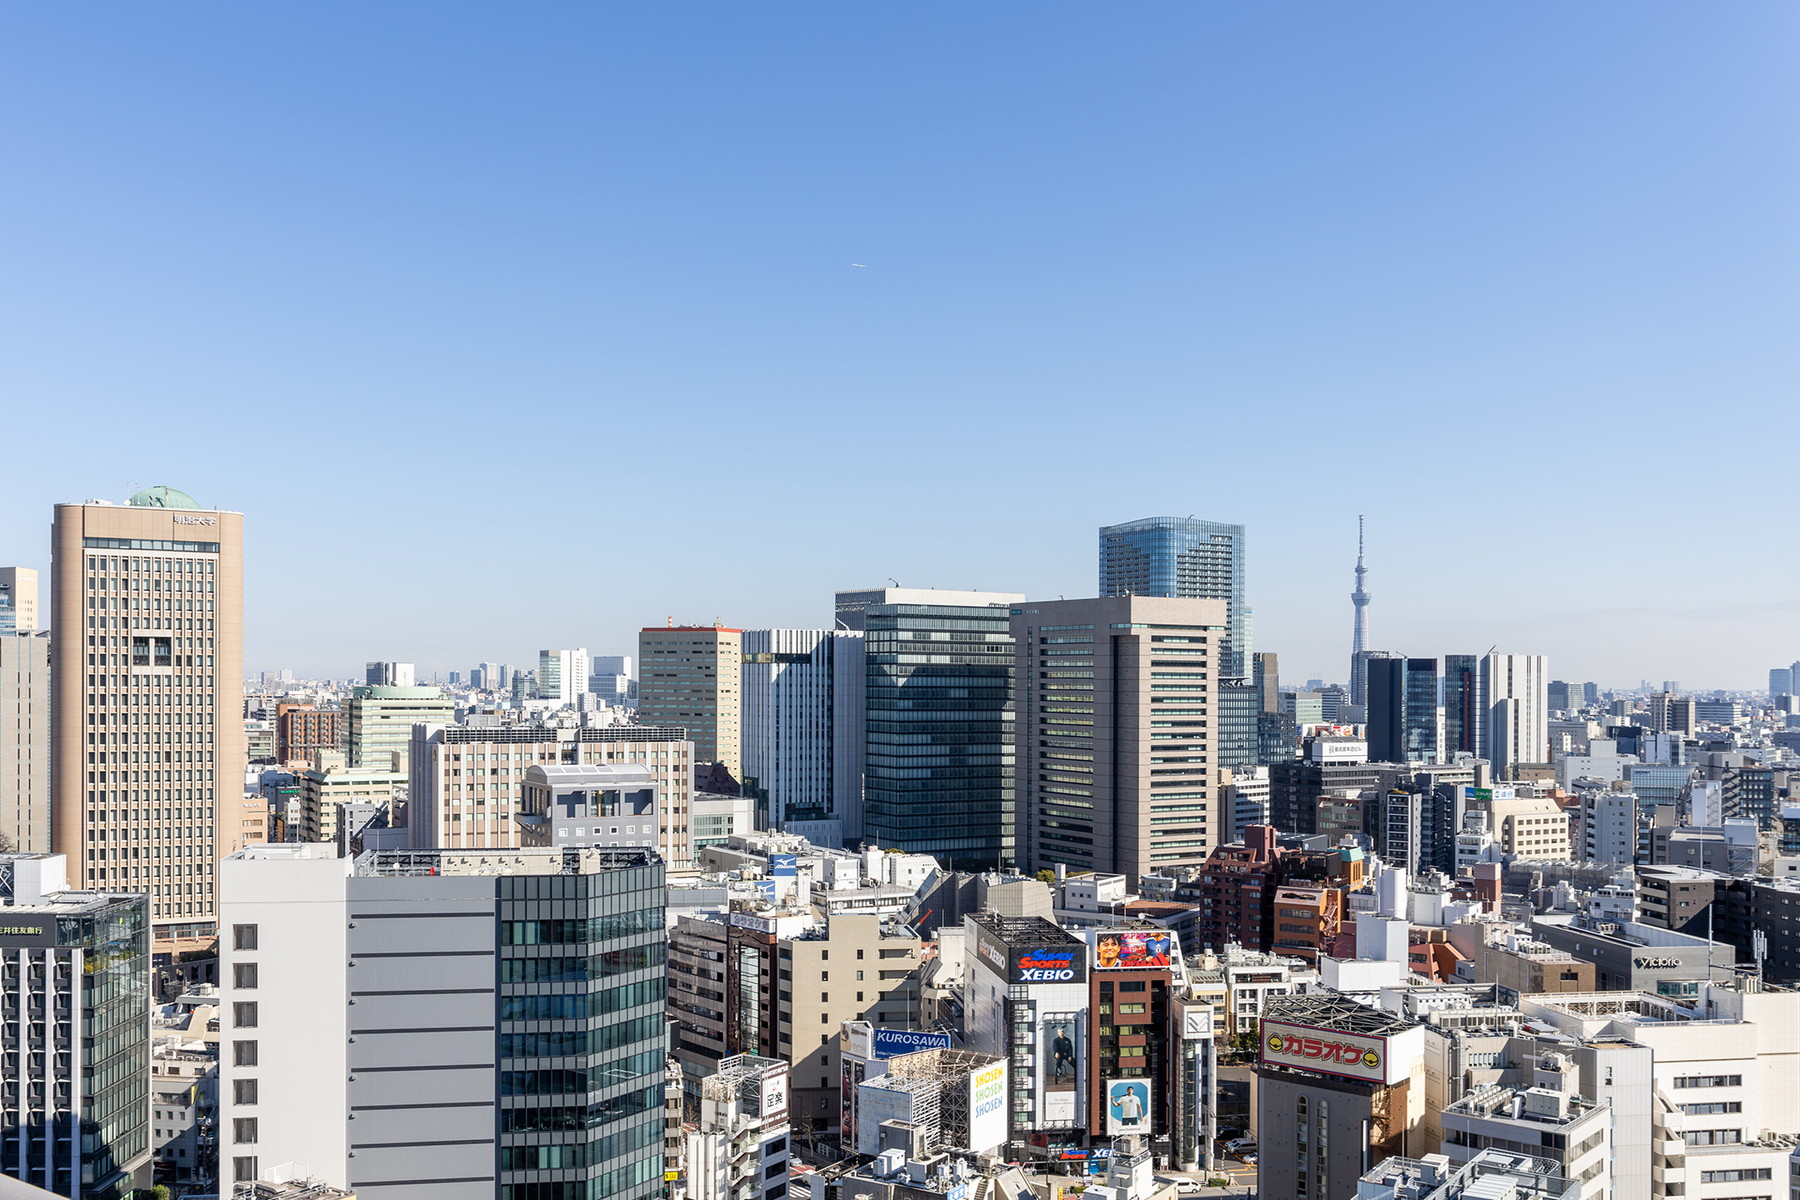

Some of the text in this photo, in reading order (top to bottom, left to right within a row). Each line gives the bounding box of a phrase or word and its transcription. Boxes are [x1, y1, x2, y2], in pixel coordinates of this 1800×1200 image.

[174, 515, 216, 525] 明治大学
[1018, 968, 1075, 981] XEBIO
[876, 1032, 946, 1048] KUROSAWA
[1283, 1035, 1364, 1064] カラオケ
[975, 1067, 1003, 1088] SHOSEN
[975, 1081, 1003, 1103] SHOSEN
[975, 1096, 1003, 1118] SHOSEN
